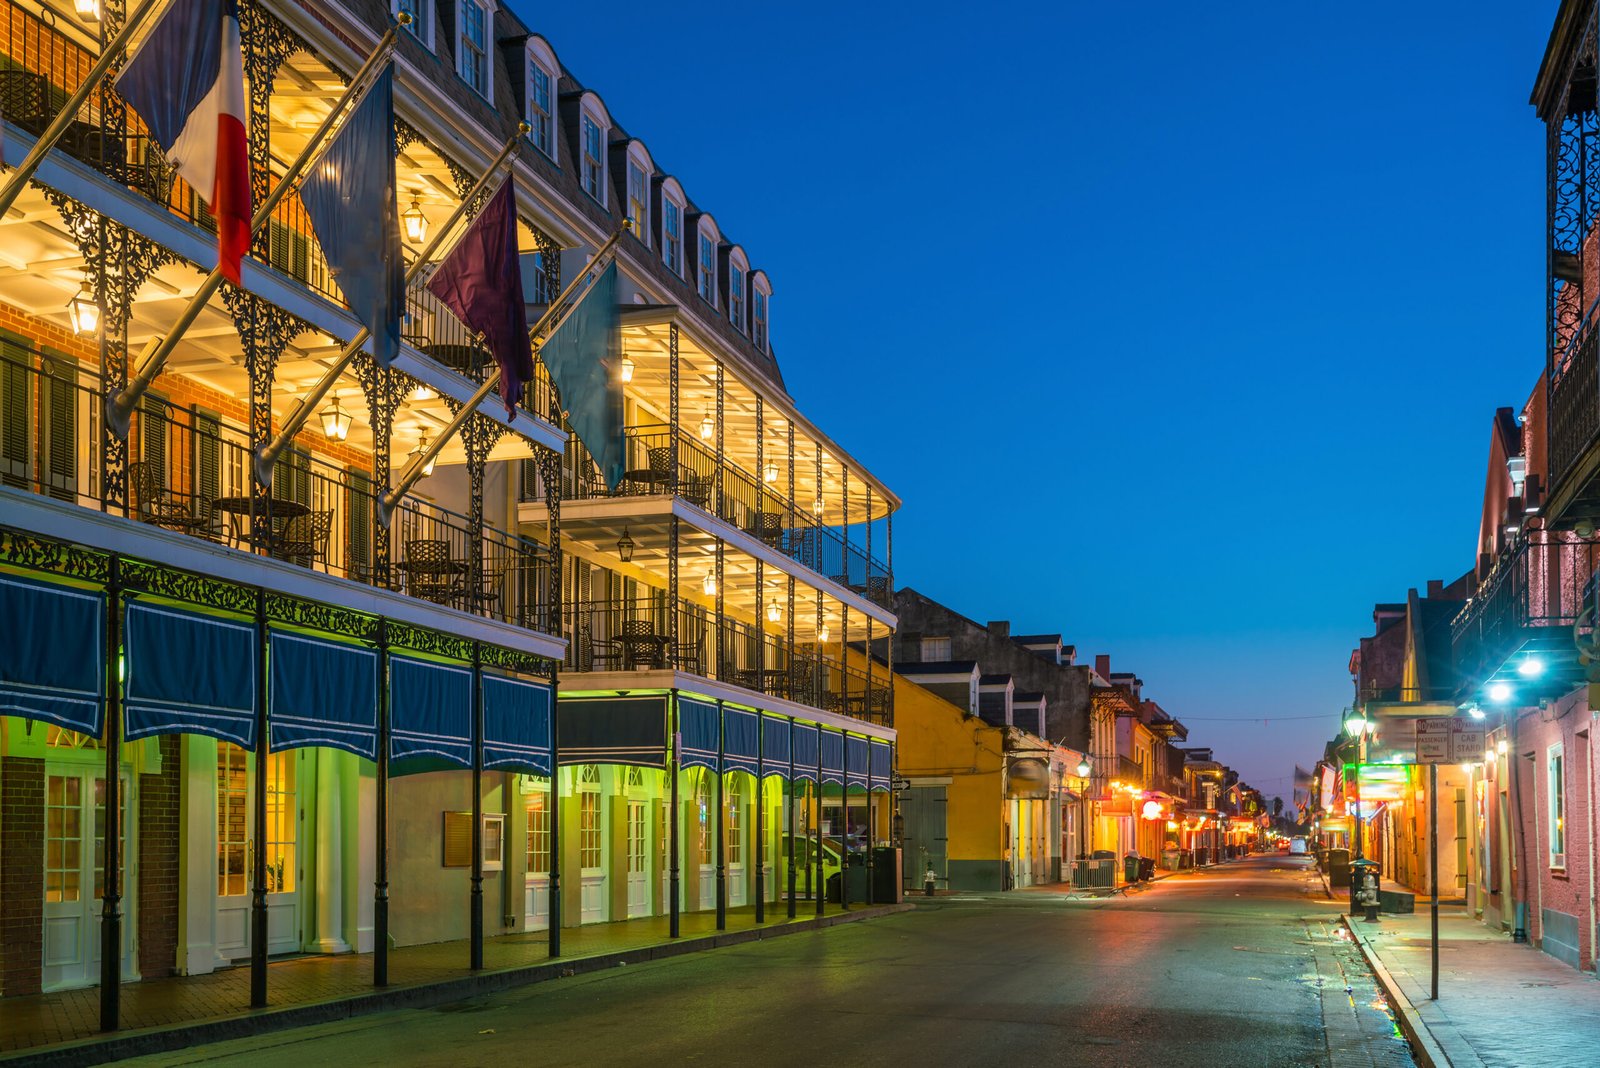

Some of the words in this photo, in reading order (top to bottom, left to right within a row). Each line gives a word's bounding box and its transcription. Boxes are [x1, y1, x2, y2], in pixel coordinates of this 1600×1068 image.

[1417, 720, 1426, 731] NO
[1427, 721, 1447, 729] PARKING
[1453, 720, 1462, 730] NO
[1461, 734, 1476, 742] CAB
[1456, 744, 1481, 752] STAND
